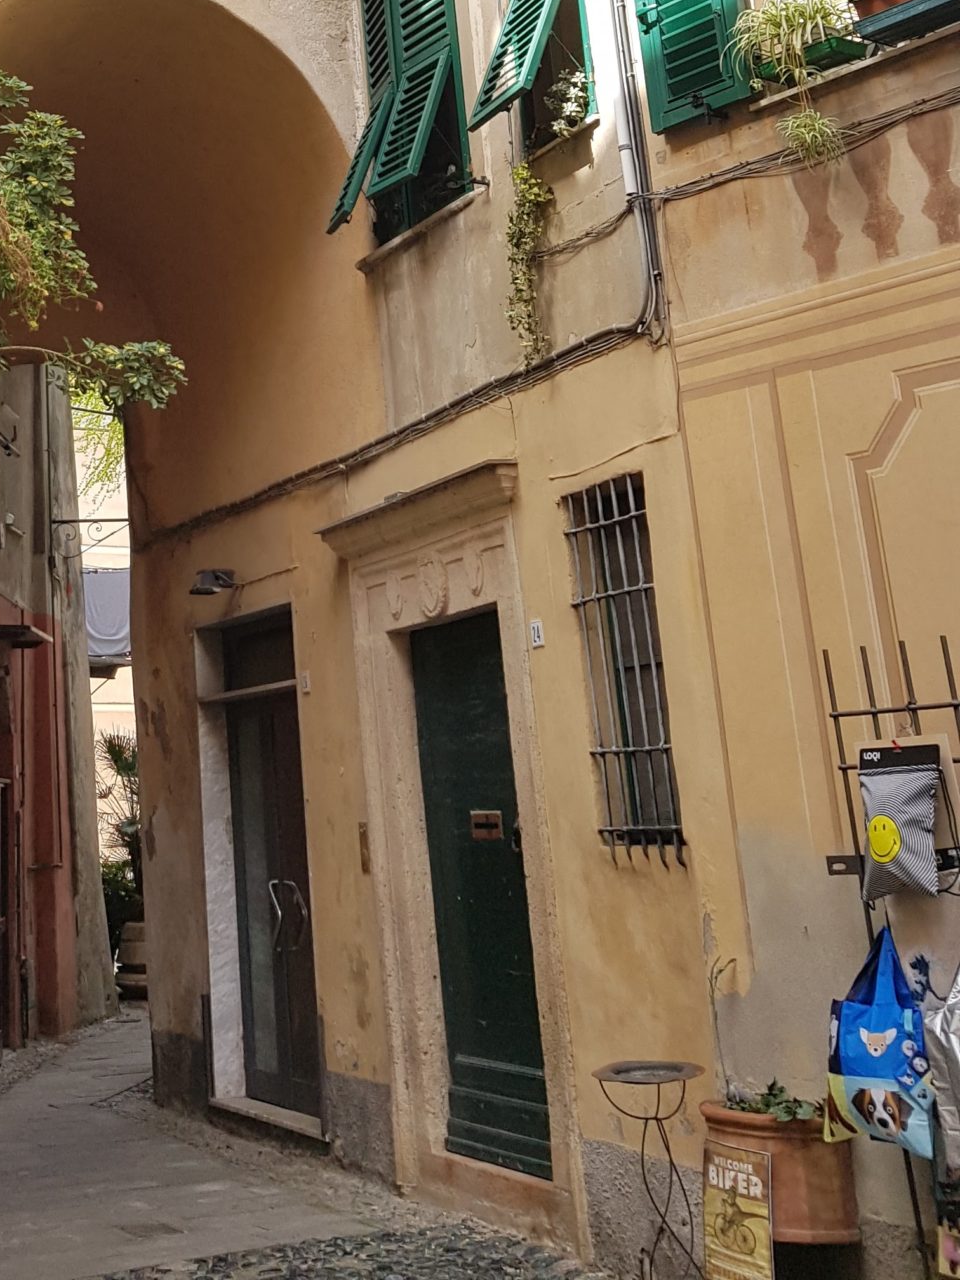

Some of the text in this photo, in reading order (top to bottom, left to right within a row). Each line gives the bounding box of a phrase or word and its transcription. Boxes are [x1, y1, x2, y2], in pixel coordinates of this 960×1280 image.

[532, 624, 541, 643] 24
[863, 751, 881, 761] LOQI
[708, 1163, 763, 1199] BIKER
